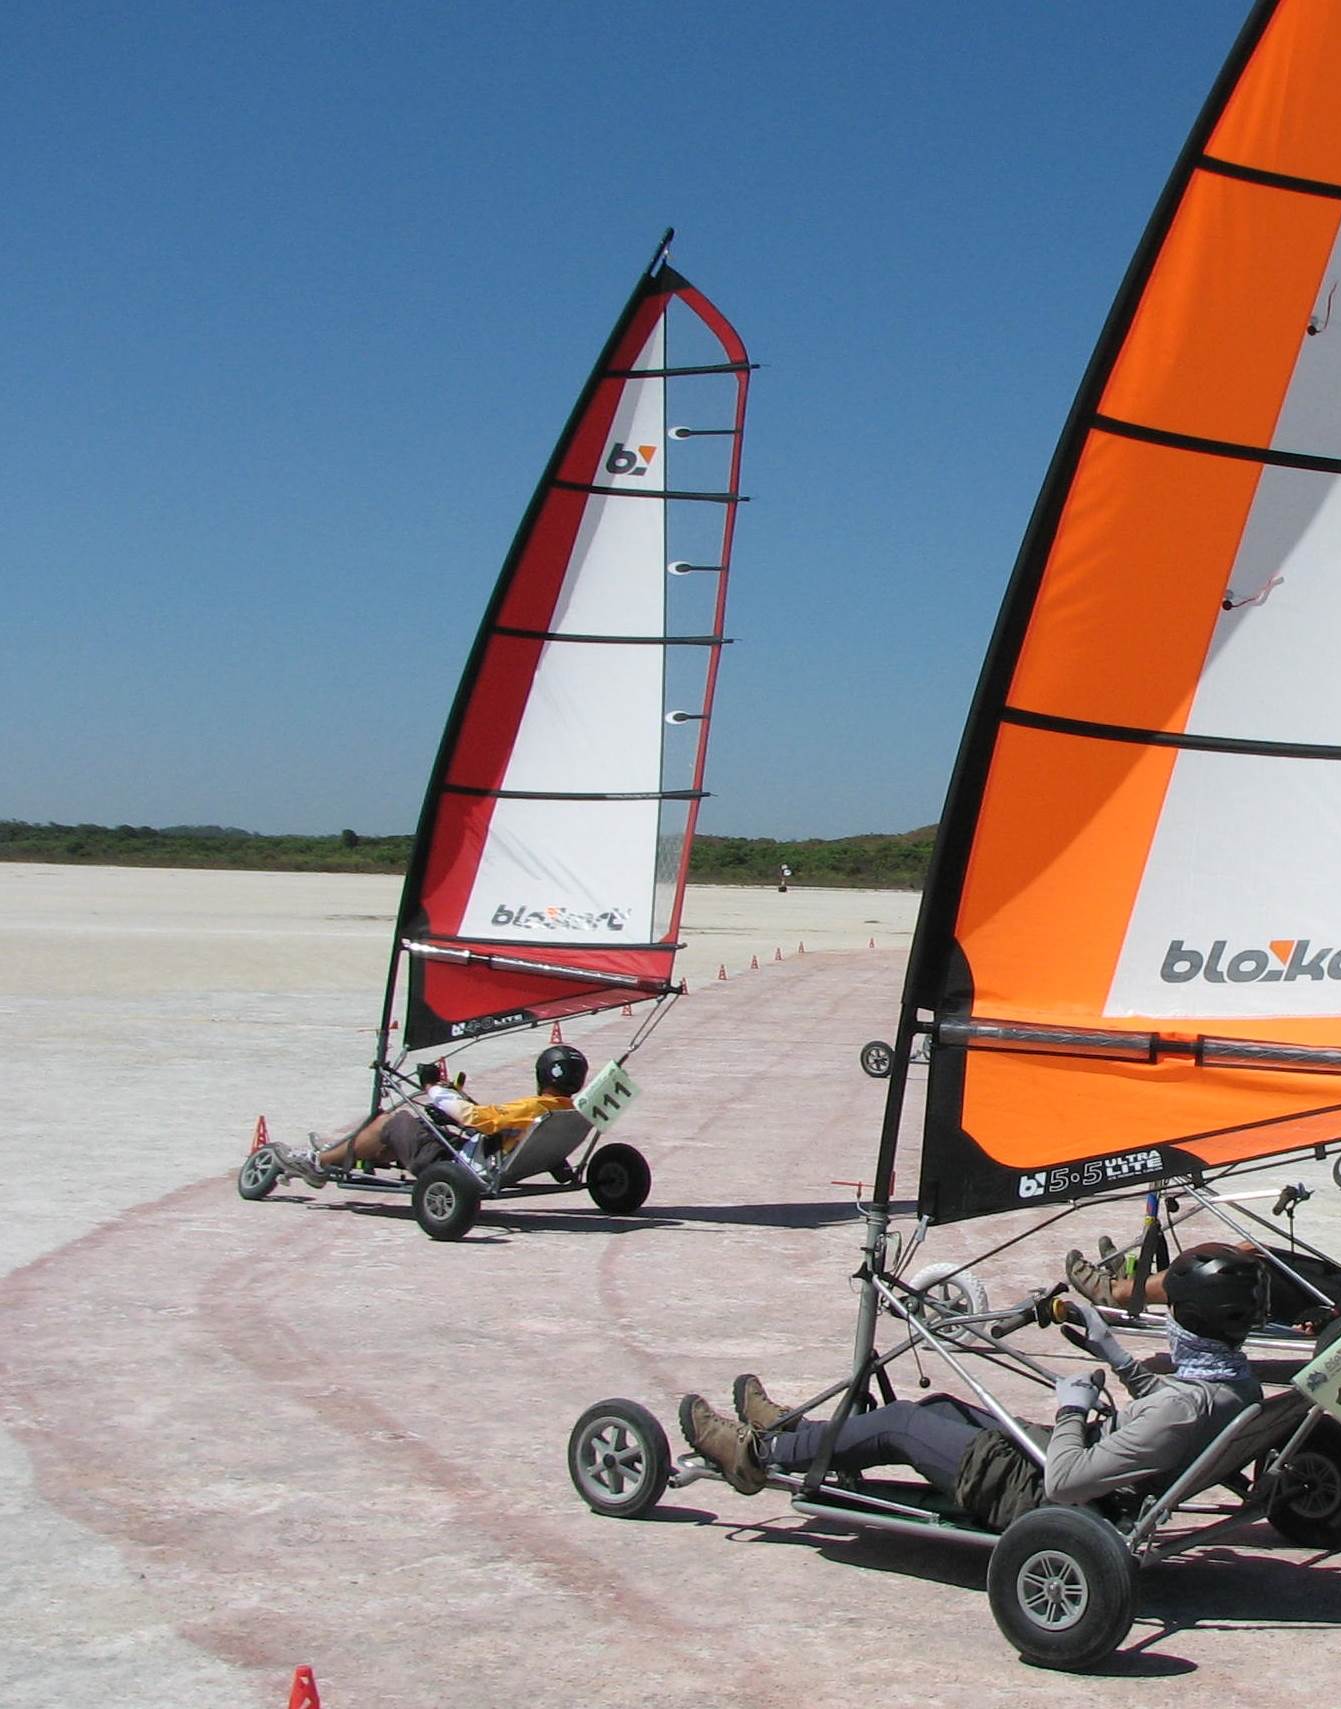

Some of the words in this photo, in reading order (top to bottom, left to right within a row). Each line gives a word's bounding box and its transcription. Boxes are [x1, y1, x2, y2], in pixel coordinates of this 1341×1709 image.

[491, 904, 627, 932] blort
[592, 1081, 632, 1122] 111
[1104, 1150, 1161, 1167] ULTRA
[1106, 1158, 1162, 1177] LITE
